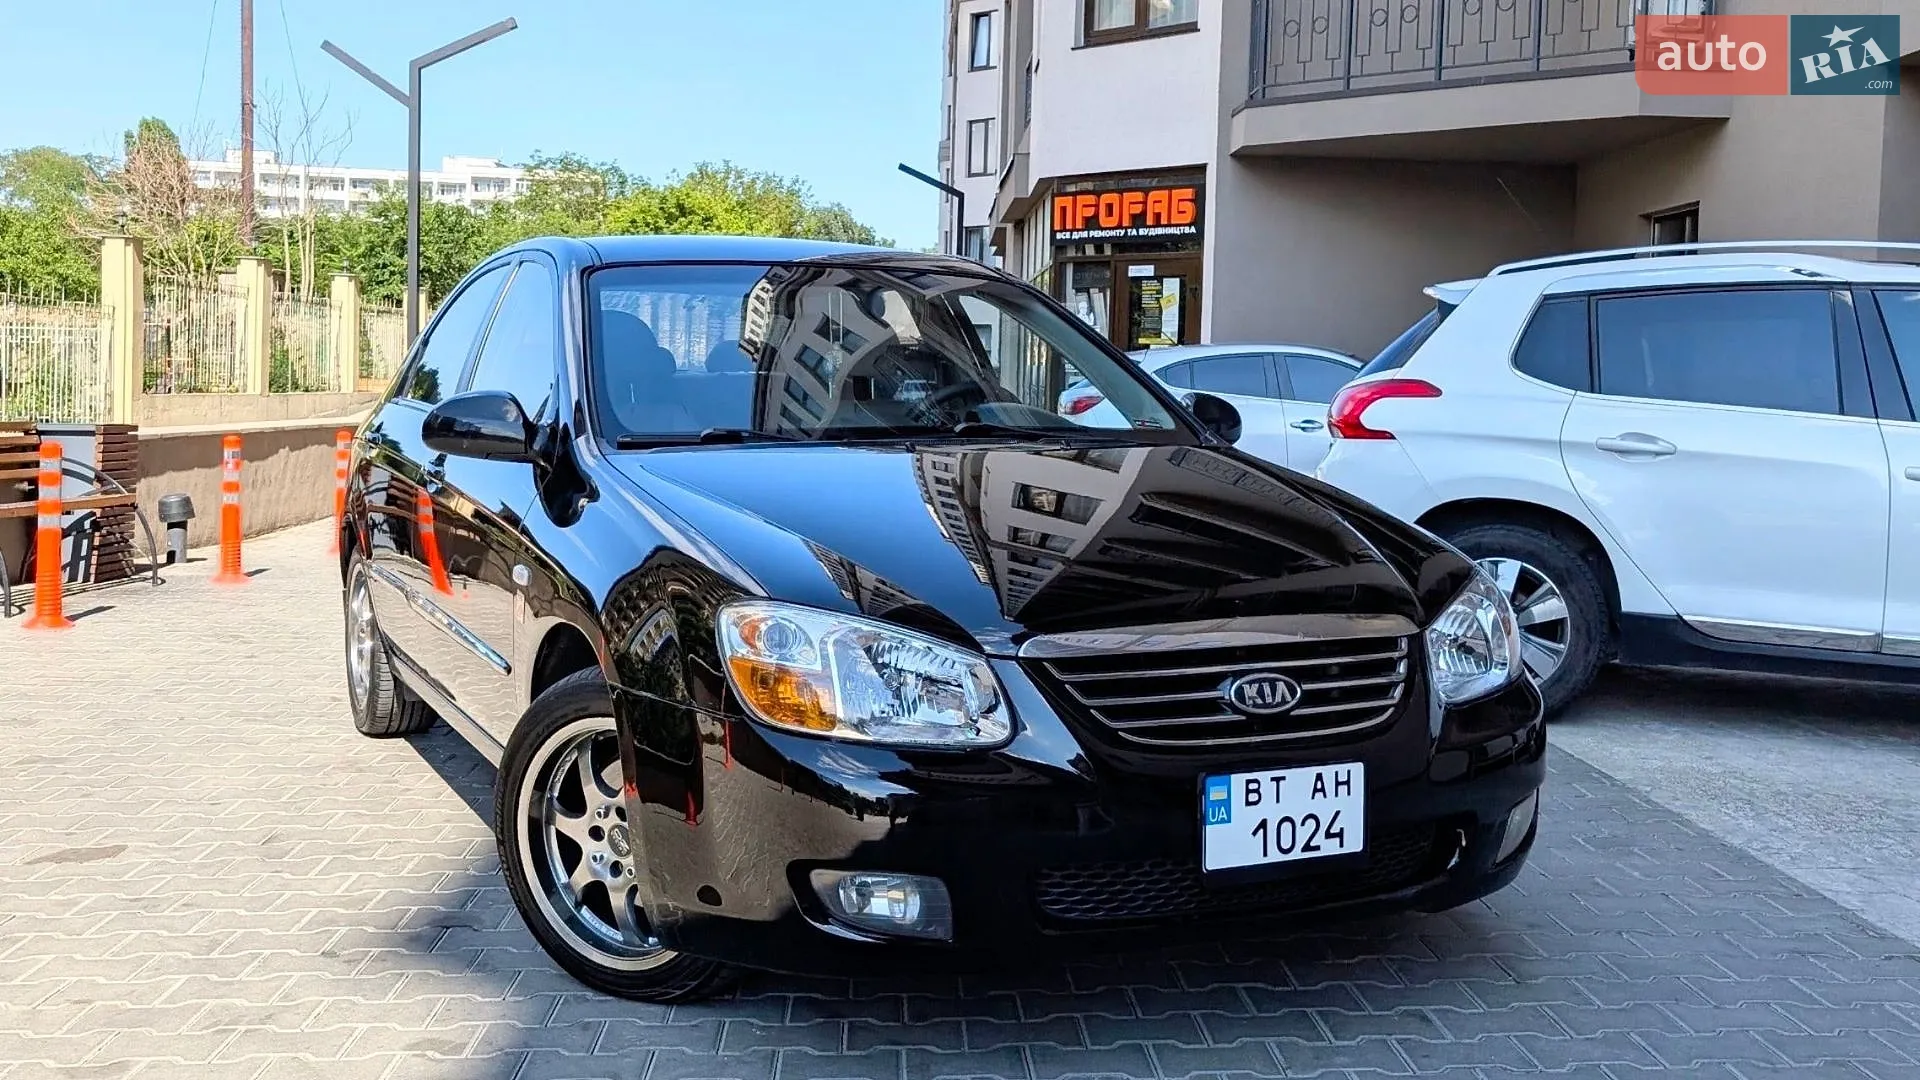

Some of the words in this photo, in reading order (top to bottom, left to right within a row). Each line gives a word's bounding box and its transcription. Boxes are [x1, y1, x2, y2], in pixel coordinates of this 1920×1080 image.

[1054, 188, 1196, 230] ПРОРАБ
[1056, 232, 1070, 240] ВСЕ
[1072, 230, 1088, 240] ДЛЯ
[1089, 229, 1125, 238] РЕМОНТУ
[1127, 228, 1137, 236] ТА
[1139, 226, 1196, 236] БУДІВНИЦТВА
[1242, 681, 1292, 706] KIA
[1209, 807, 1228, 822] UA
[1251, 810, 1344, 858] 1024
